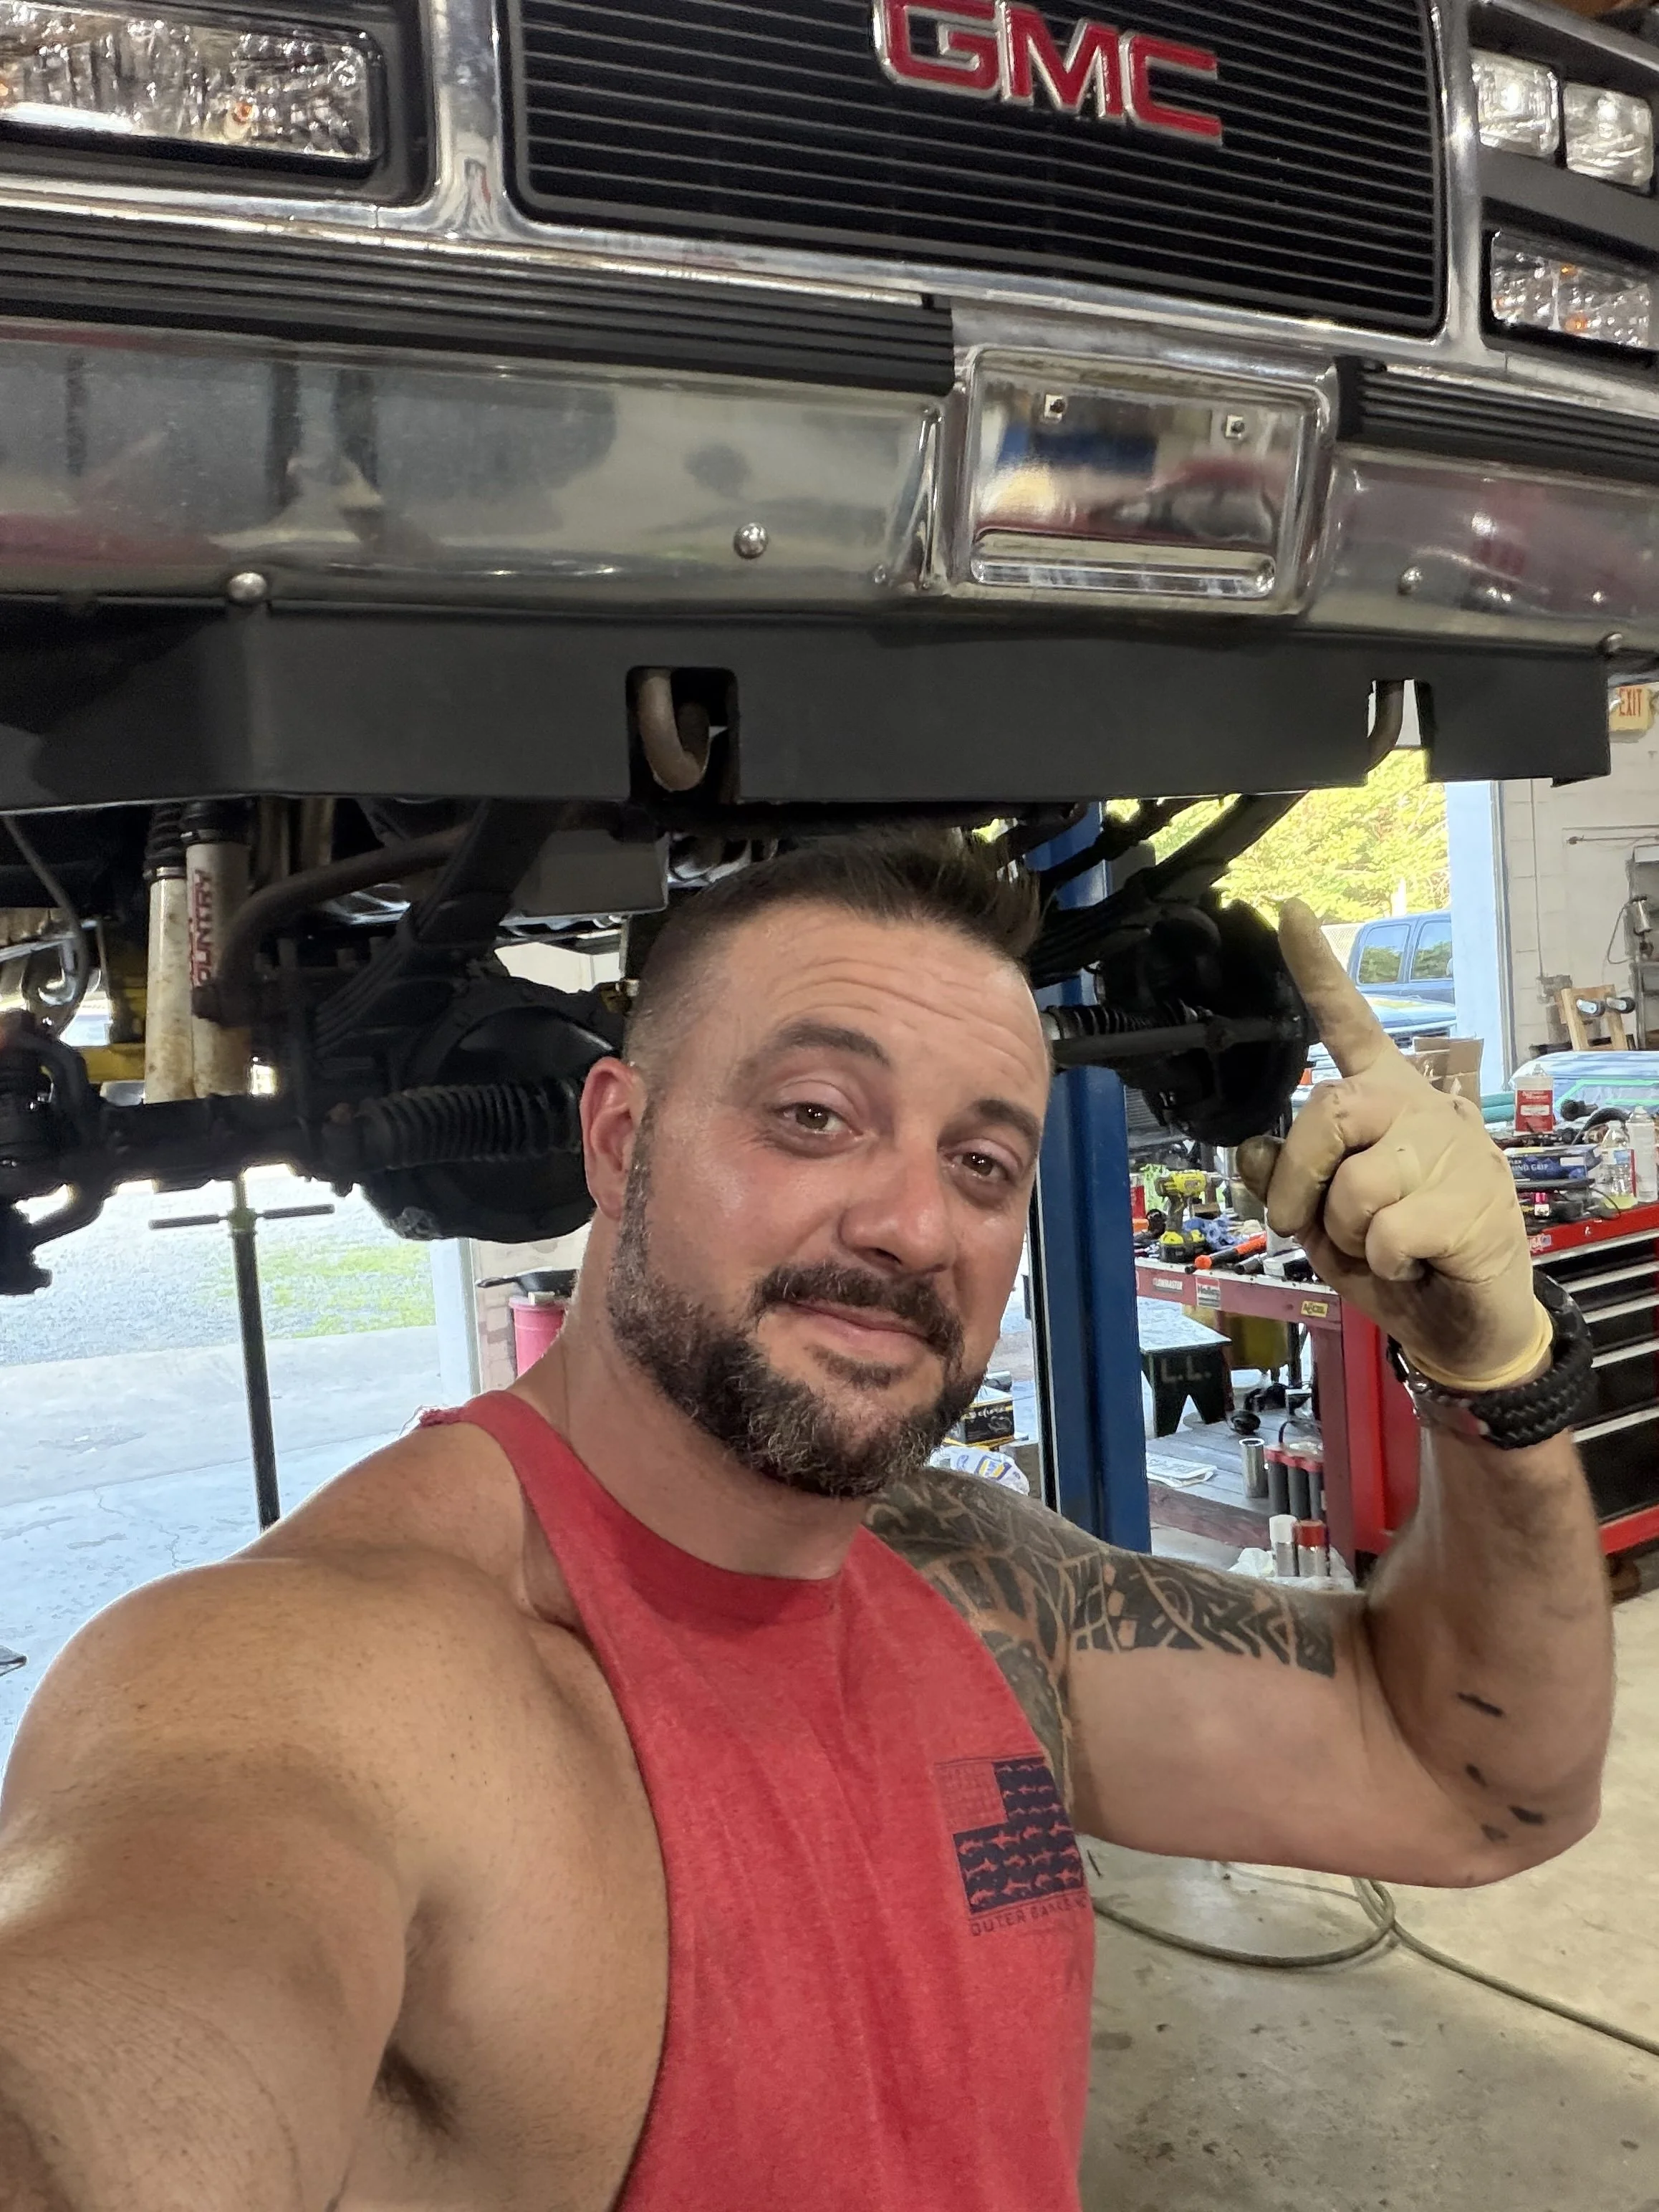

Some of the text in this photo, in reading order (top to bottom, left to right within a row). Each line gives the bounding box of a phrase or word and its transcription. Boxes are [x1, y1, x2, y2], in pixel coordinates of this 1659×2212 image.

[871, 0, 1224, 149] GMC
[1618, 688, 1643, 717] EXIT
[970, 1909, 1026, 1936] OUTER
